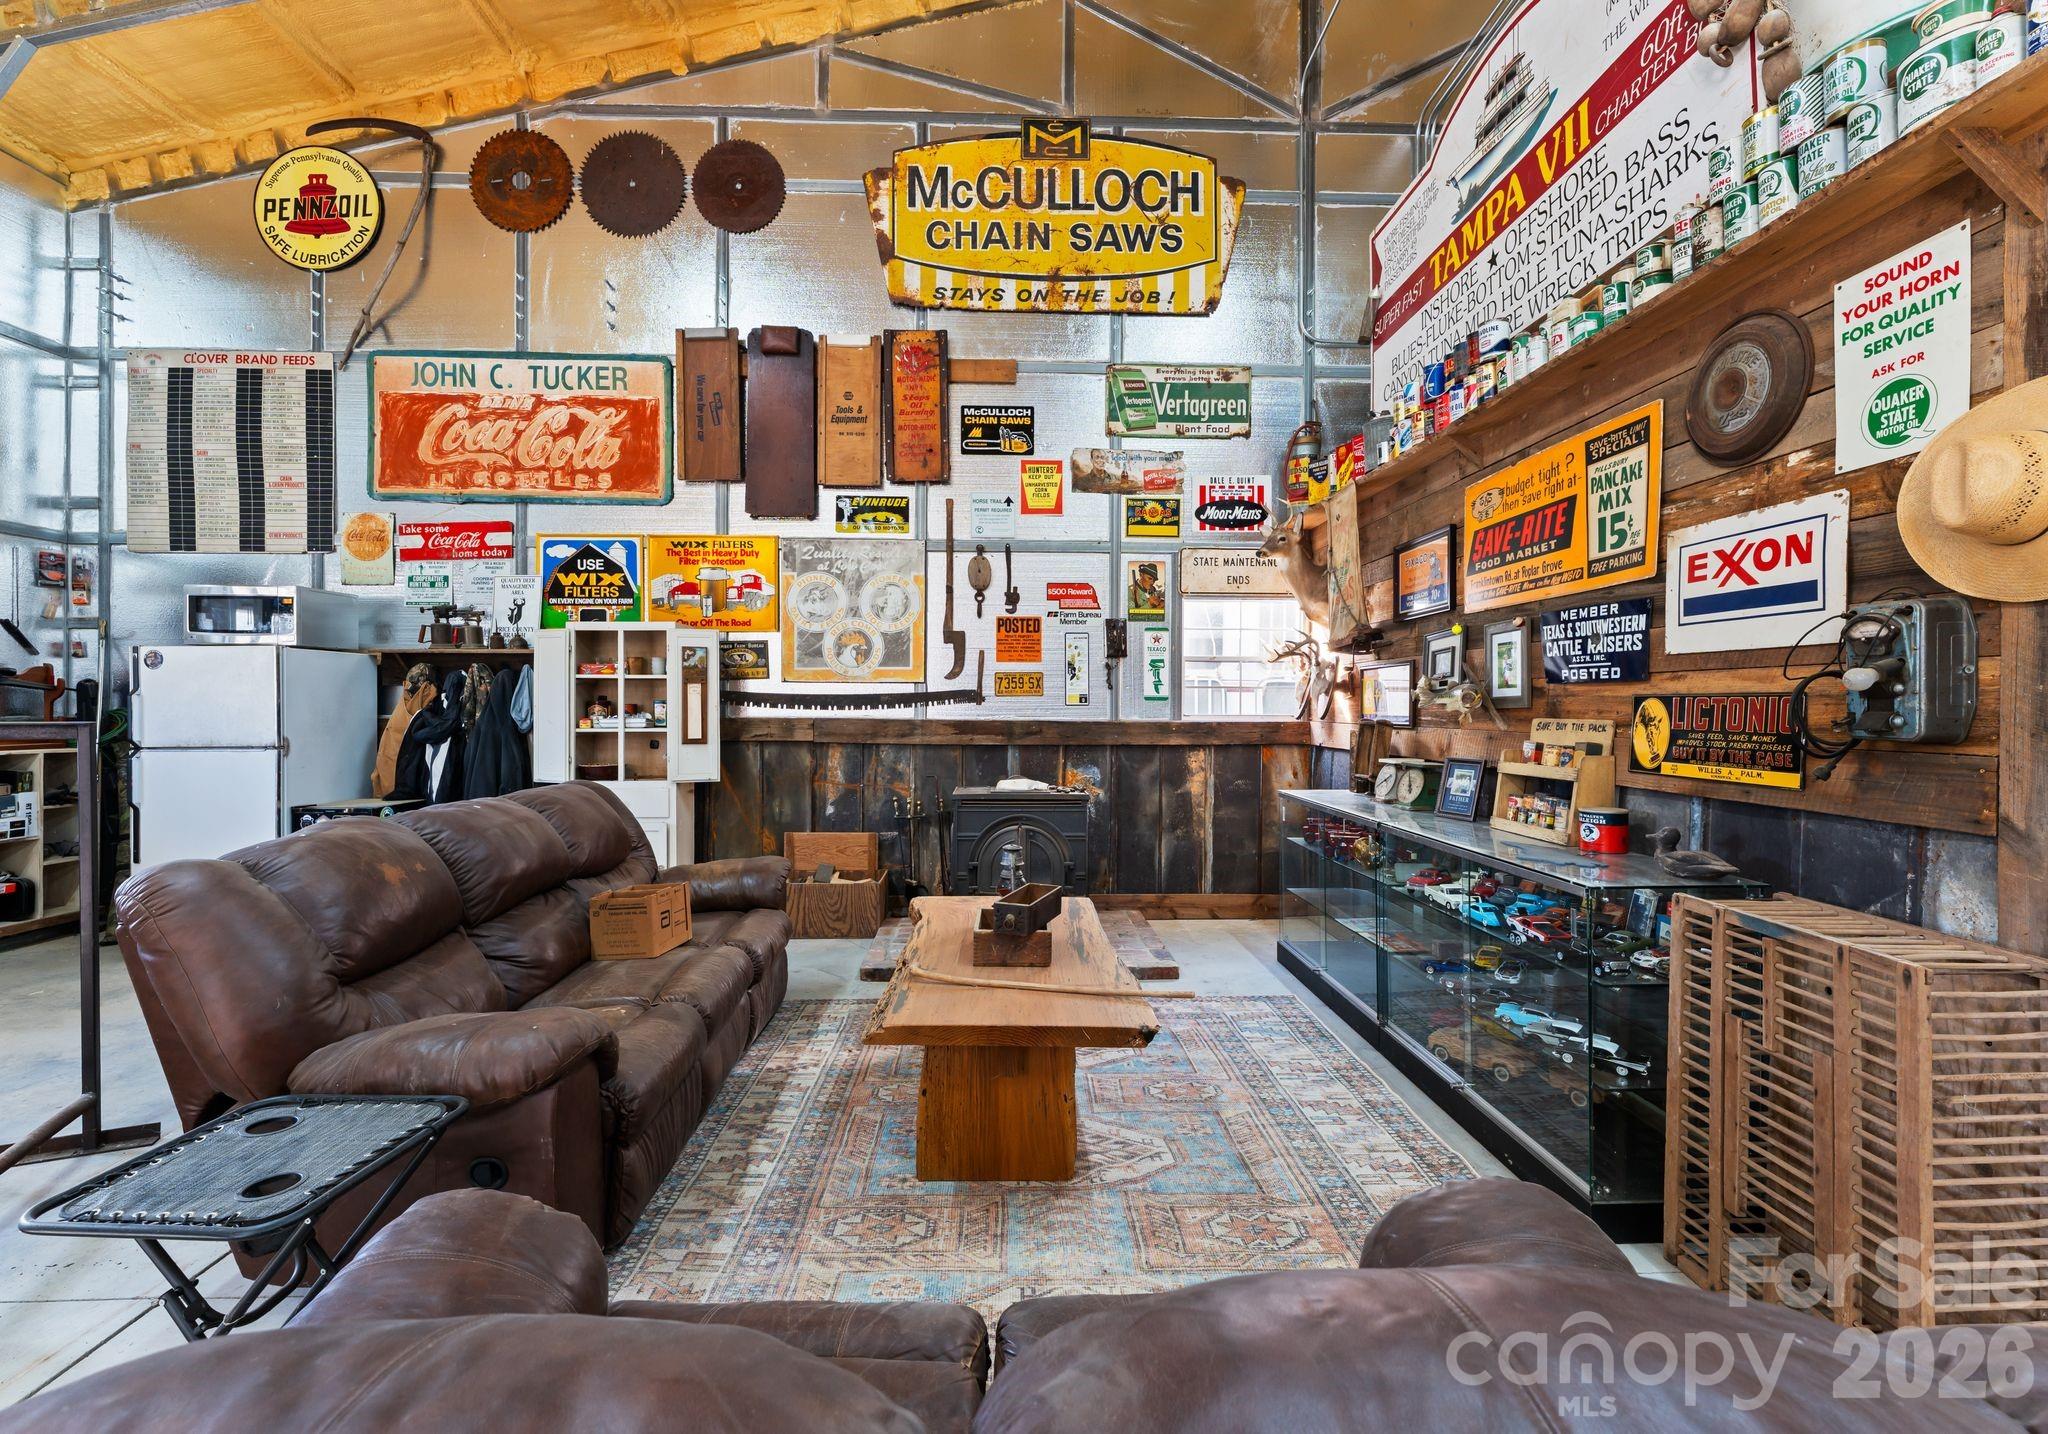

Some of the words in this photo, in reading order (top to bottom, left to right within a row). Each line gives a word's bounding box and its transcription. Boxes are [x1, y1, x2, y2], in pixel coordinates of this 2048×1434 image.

[1602, 16, 1626, 52] THE
[1825, 73, 1848, 92] STATE
[1904, 58, 1938, 86] QUAKER
[1842, 88, 1854, 96] OIL
[1906, 72, 1934, 98] STATE
[1624, 107, 1691, 183] BASS
[265, 160, 290, 188] Supreme
[290, 152, 341, 166] Pennsylvania
[342, 160, 364, 184] Quality
[907, 165, 1203, 215] McCULLOCH
[1374, 305, 1401, 340] SUPER
[1401, 276, 1426, 312] FAST
[1428, 174, 1526, 292] TAMPA
[1536, 96, 1590, 186] VII
[1596, 44, 1678, 136] CHARTER
[264, 194, 372, 222] PENNZOIL
[1501, 258, 1548, 312] HOLE
[1552, 122, 1719, 271] TUNA-SHARKS
[264, 226, 292, 255] SAFE
[292, 226, 370, 265] LUBRICATION
[926, 220, 1052, 251] CHAIN
[1070, 223, 1184, 253] SAWS
[1420, 262, 1480, 332] INSHORE
[1504, 143, 1608, 255] OFFSHORE
[1528, 252, 1599, 321] WRECK
[1600, 198, 1668, 265] TRIPS
[1864, 250, 1932, 294] SOUND
[933, 287, 1006, 302] STAYS
[1017, 289, 1049, 302] ON
[1063, 290, 1105, 303] THE
[1842, 292, 1893, 324] YOUR
[1900, 260, 1960, 301] HORN
[1842, 321, 1874, 346] FOR
[1878, 282, 1962, 330] QUALITY
[1864, 318, 1934, 359] SERVICE
[184, 354, 228, 364] CLOVER
[236, 354, 278, 364] BRAND
[283, 354, 315, 366] FEEDS
[1872, 362, 1895, 379] ASK
[1900, 351, 1925, 368] FOR
[410, 362, 476, 387] JOHN
[490, 364, 513, 389] C.
[528, 365, 628, 390] TUCKER
[836, 406, 854, 414] Tools
[857, 406, 863, 414] &
[1152, 383, 1246, 422] Vertagreen
[1871, 383, 1925, 415] QUAKER
[830, 415, 868, 424] Equipment
[964, 408, 1031, 416] McCULLOCH
[1880, 404, 1916, 429] STATE
[417, 402, 627, 470] Coca-Cola
[1175, 425, 1201, 434] Plant
[1206, 425, 1230, 434] Food
[1590, 428, 1628, 451] SAVE-RITE
[1876, 422, 1905, 439] MOTOR
[1906, 418, 1921, 431] OIL
[1594, 456, 1628, 474] PILLSBURY
[1504, 474, 1535, 498] budget
[1539, 462, 1560, 485] tight
[1590, 460, 1643, 495] PANCAKE
[852, 498, 908, 507] EVINRUDE
[1522, 490, 1542, 506] save
[1544, 479, 1564, 498] right
[1598, 485, 1632, 514] MIX
[1200, 506, 1262, 521] MoorMan's
[401, 525, 422, 534] Take
[428, 532, 482, 550] Coca-Cola
[452, 550, 478, 558] home
[482, 548, 508, 558] today
[577, 559, 604, 570] USE
[666, 548, 682, 557] The
[684, 549, 700, 557] Best
[712, 549, 738, 558] Heavy
[740, 549, 760, 558] Duty
[679, 558, 700, 566] Filter
[702, 558, 746, 566] Protection
[1194, 558, 1218, 567] STATE
[1476, 557, 1500, 572] FOOD
[1506, 540, 1558, 562] MARKET
[1590, 561, 1608, 574] FREE
[1608, 550, 1643, 570] PARKING
[1687, 530, 1814, 588] EXXON
[1542, 560, 1563, 574] Grove
[556, 572, 625, 586] WIX
[1227, 576, 1250, 584] ENDS
[564, 586, 620, 598] FILTERS
[1560, 604, 1618, 621] MEMBER
[998, 618, 1040, 634] POSTED
[1543, 624, 1565, 640] TEXAS
[1567, 622, 1574, 638] &
[1575, 614, 1646, 637] SOUTHWESTERN
[1546, 639, 1582, 658] CATTLE
[1562, 667, 1620, 680] POSTED
[1556, 722, 1568, 730] BUY
[1572, 722, 1584, 732] THE
[1588, 724, 1607, 732] PACK
[1688, 732, 1705, 740] SAVES
[1728, 734, 1749, 742] SAVES
[1672, 746, 1694, 759] BUY
[1696, 747, 1708, 760] IT
[1710, 748, 1725, 762] BY
[1728, 750, 1752, 764] THE
[1756, 751, 1794, 768] CASE
[1729, 742, 1760, 750] PREVENTS
[1761, 744, 1792, 752] DISEASE
